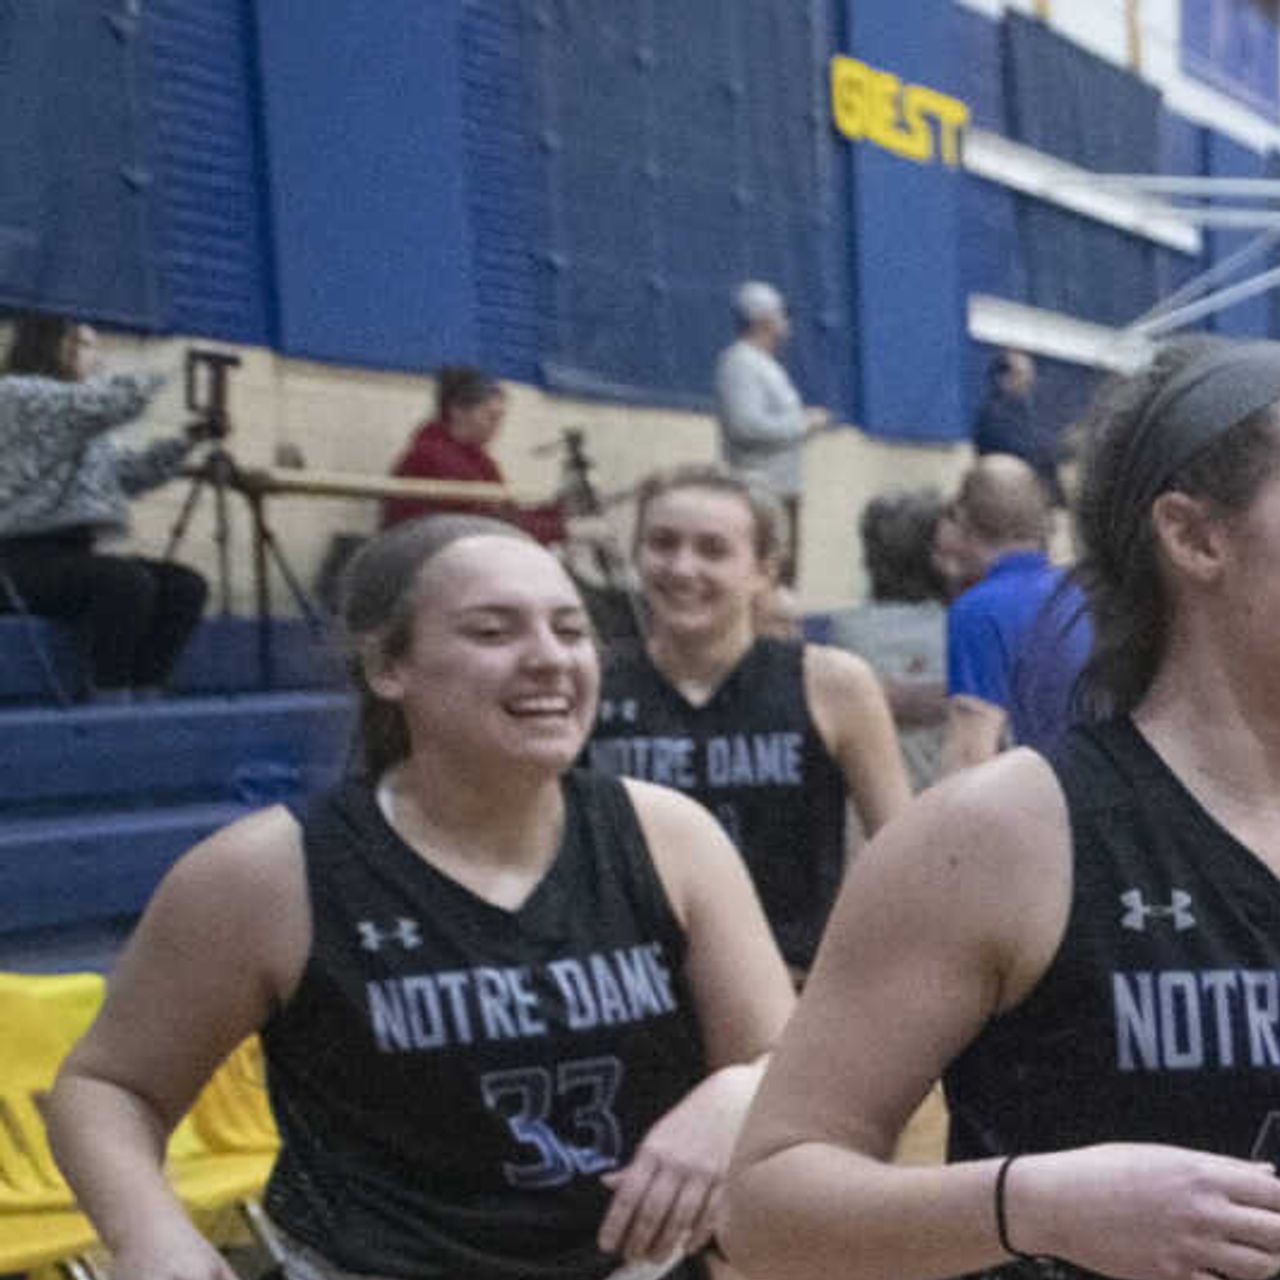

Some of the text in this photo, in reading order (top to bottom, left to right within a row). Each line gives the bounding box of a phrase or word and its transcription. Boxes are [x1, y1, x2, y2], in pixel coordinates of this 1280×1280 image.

[707, 733, 803, 786] DAME
[367, 967, 549, 1052] NOTRE
[480, 1055, 622, 1188] 33
